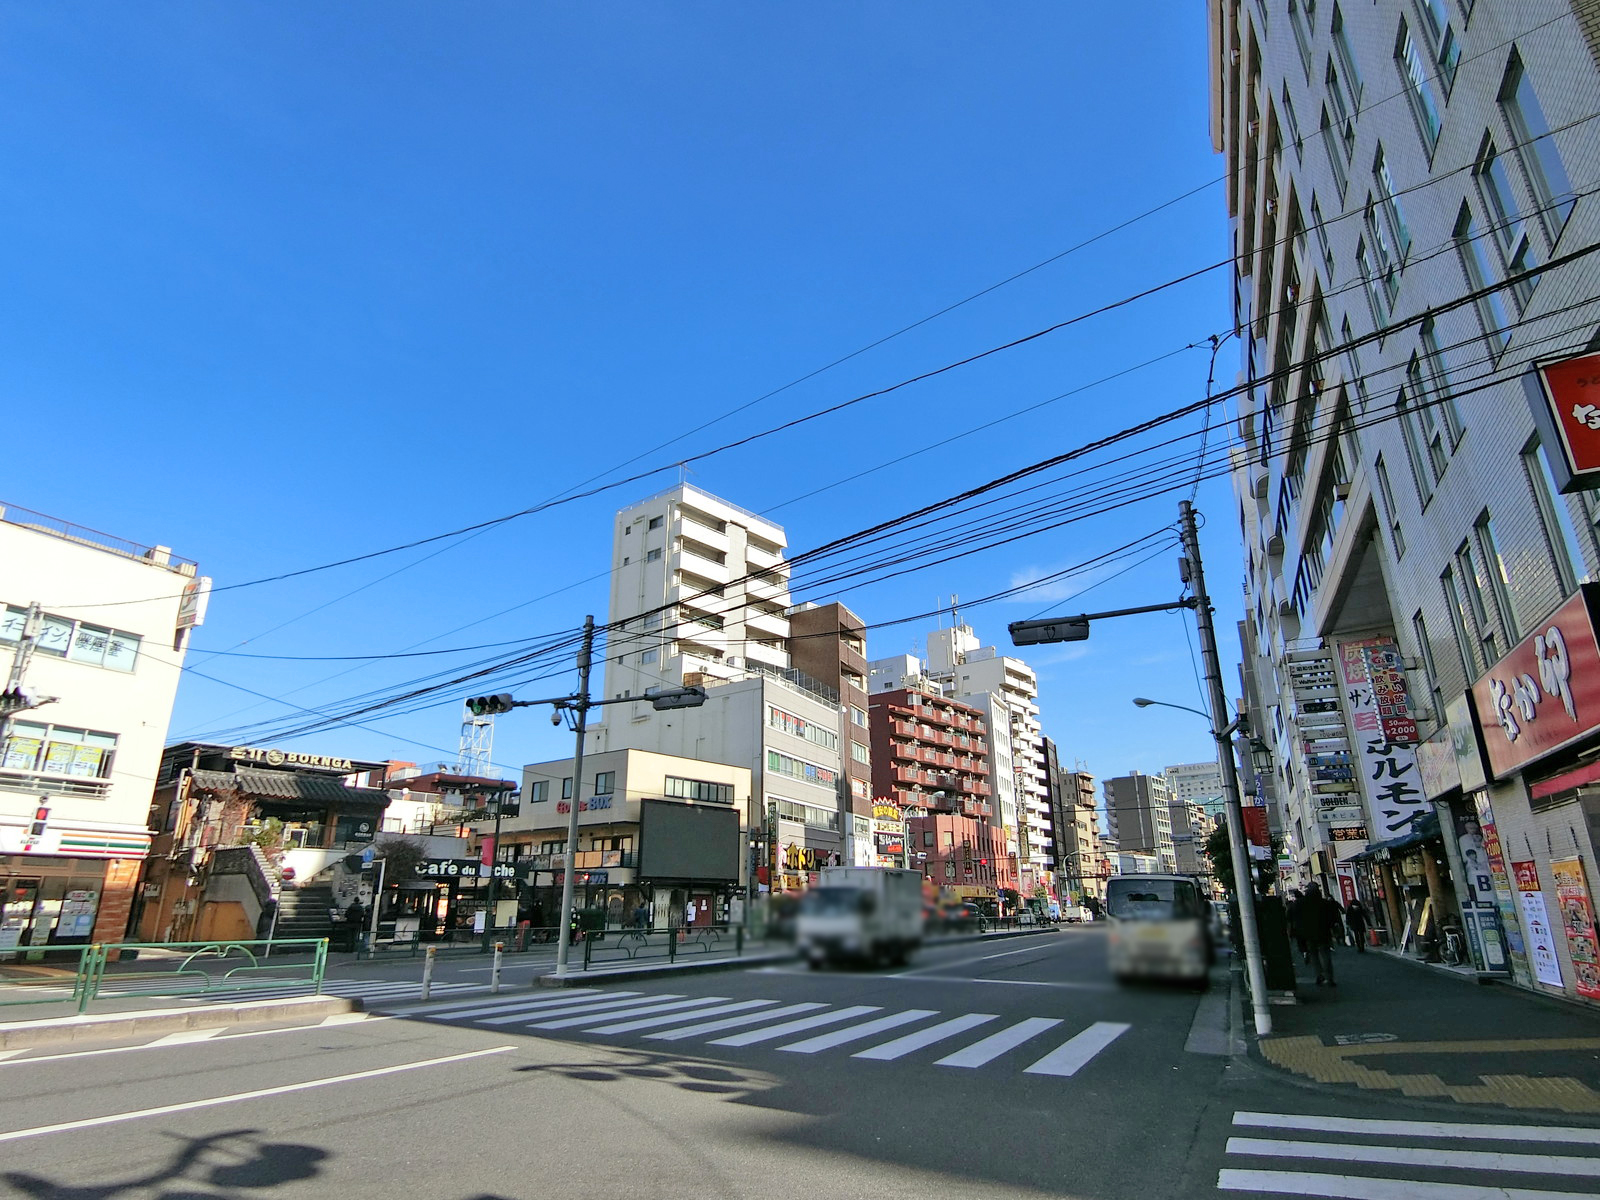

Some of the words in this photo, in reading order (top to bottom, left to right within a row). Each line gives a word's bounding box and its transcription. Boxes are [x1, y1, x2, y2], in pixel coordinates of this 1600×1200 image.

[287, 753, 352, 769] BORNGA
[588, 796, 613, 811] BOX
[415, 859, 458, 875] Café
[461, 865, 476, 875] du
